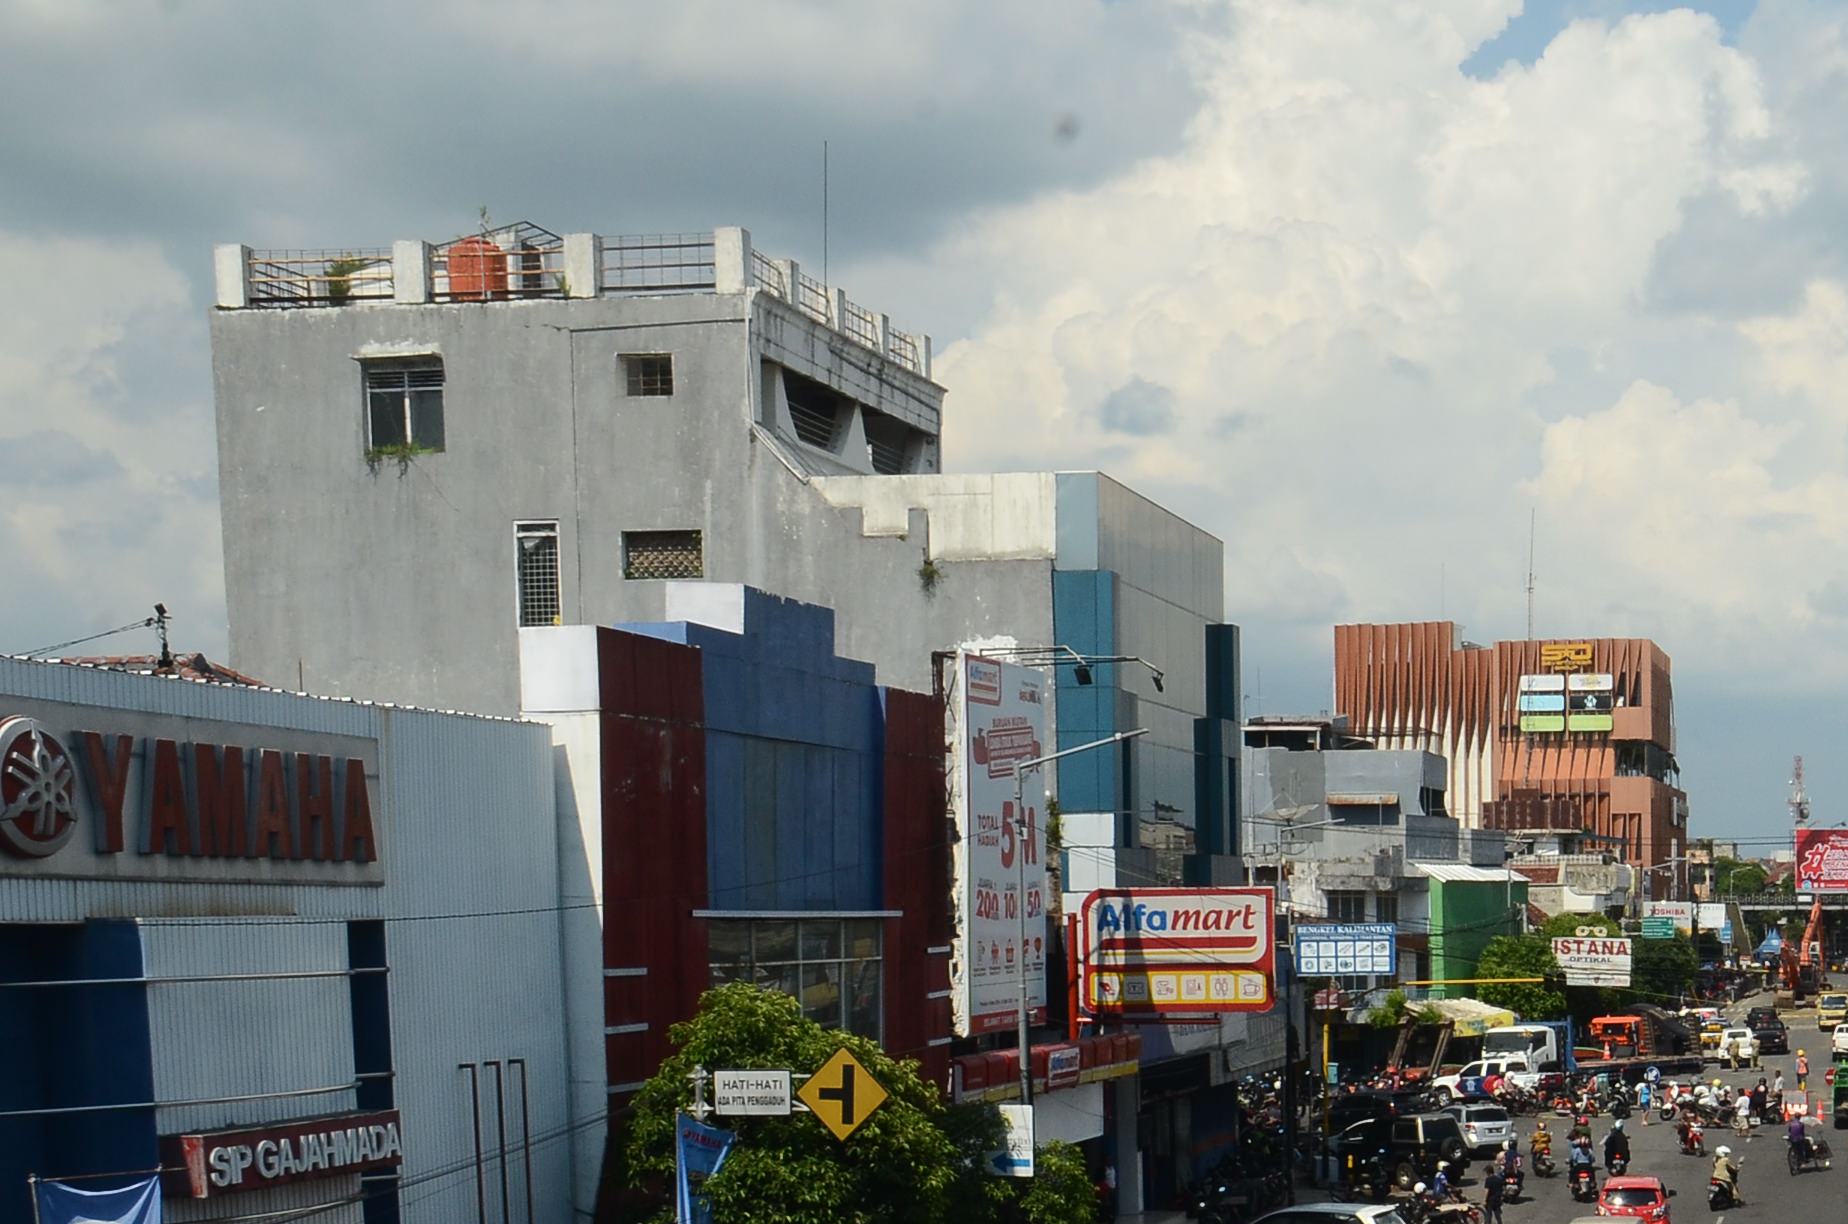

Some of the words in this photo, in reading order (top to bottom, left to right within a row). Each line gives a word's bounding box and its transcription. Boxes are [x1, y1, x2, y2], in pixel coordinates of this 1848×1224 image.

[80, 730, 377, 862] YAMAHA
[1097, 904, 1257, 932] Alfamart
[1553, 939, 1629, 956] ISTANA
[722, 1080, 782, 1090] HATI-HATI
[209, 1144, 251, 1187] SIP
[256, 1121, 401, 1180] GAJAHMADA
